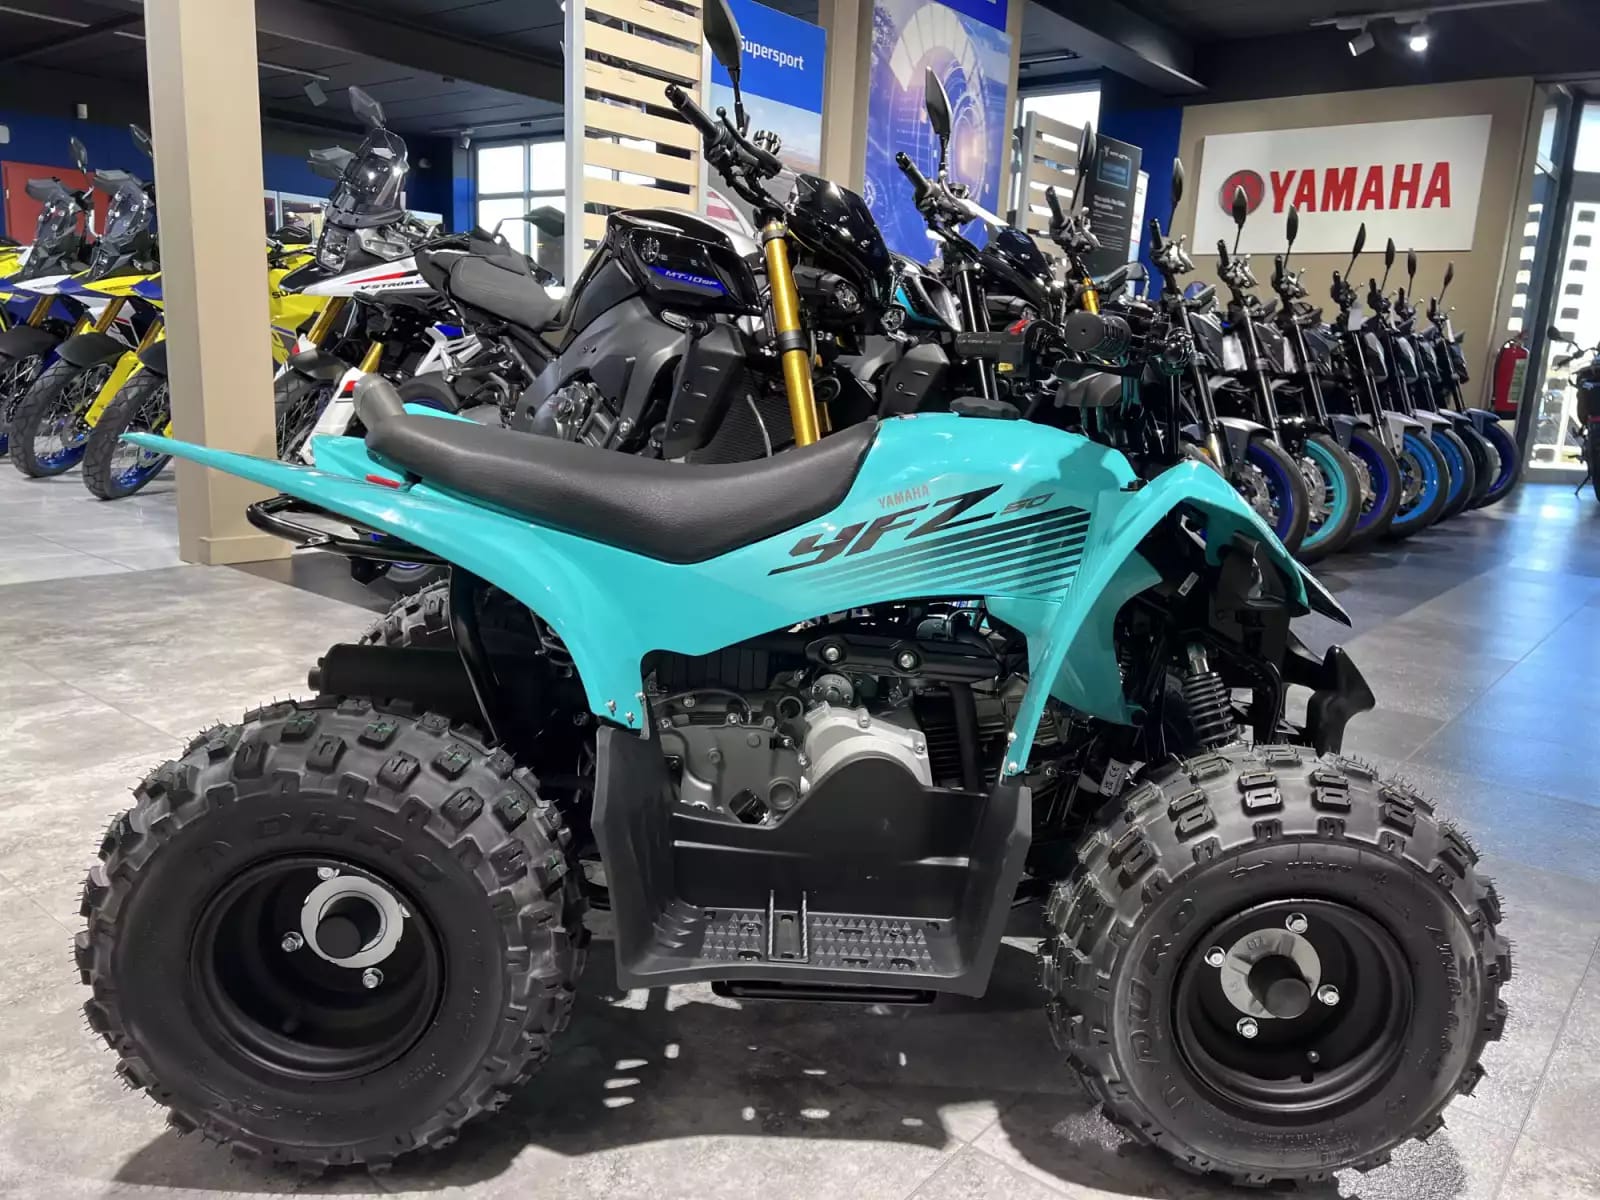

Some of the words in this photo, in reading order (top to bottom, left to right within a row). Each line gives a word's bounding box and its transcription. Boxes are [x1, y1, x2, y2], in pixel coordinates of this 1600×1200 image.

[740, 35, 804, 71] Supersport
[1270, 162, 1450, 214] YAMAHA
[877, 484, 930, 510] YAMAHA
[1000, 492, 1055, 515] 50
